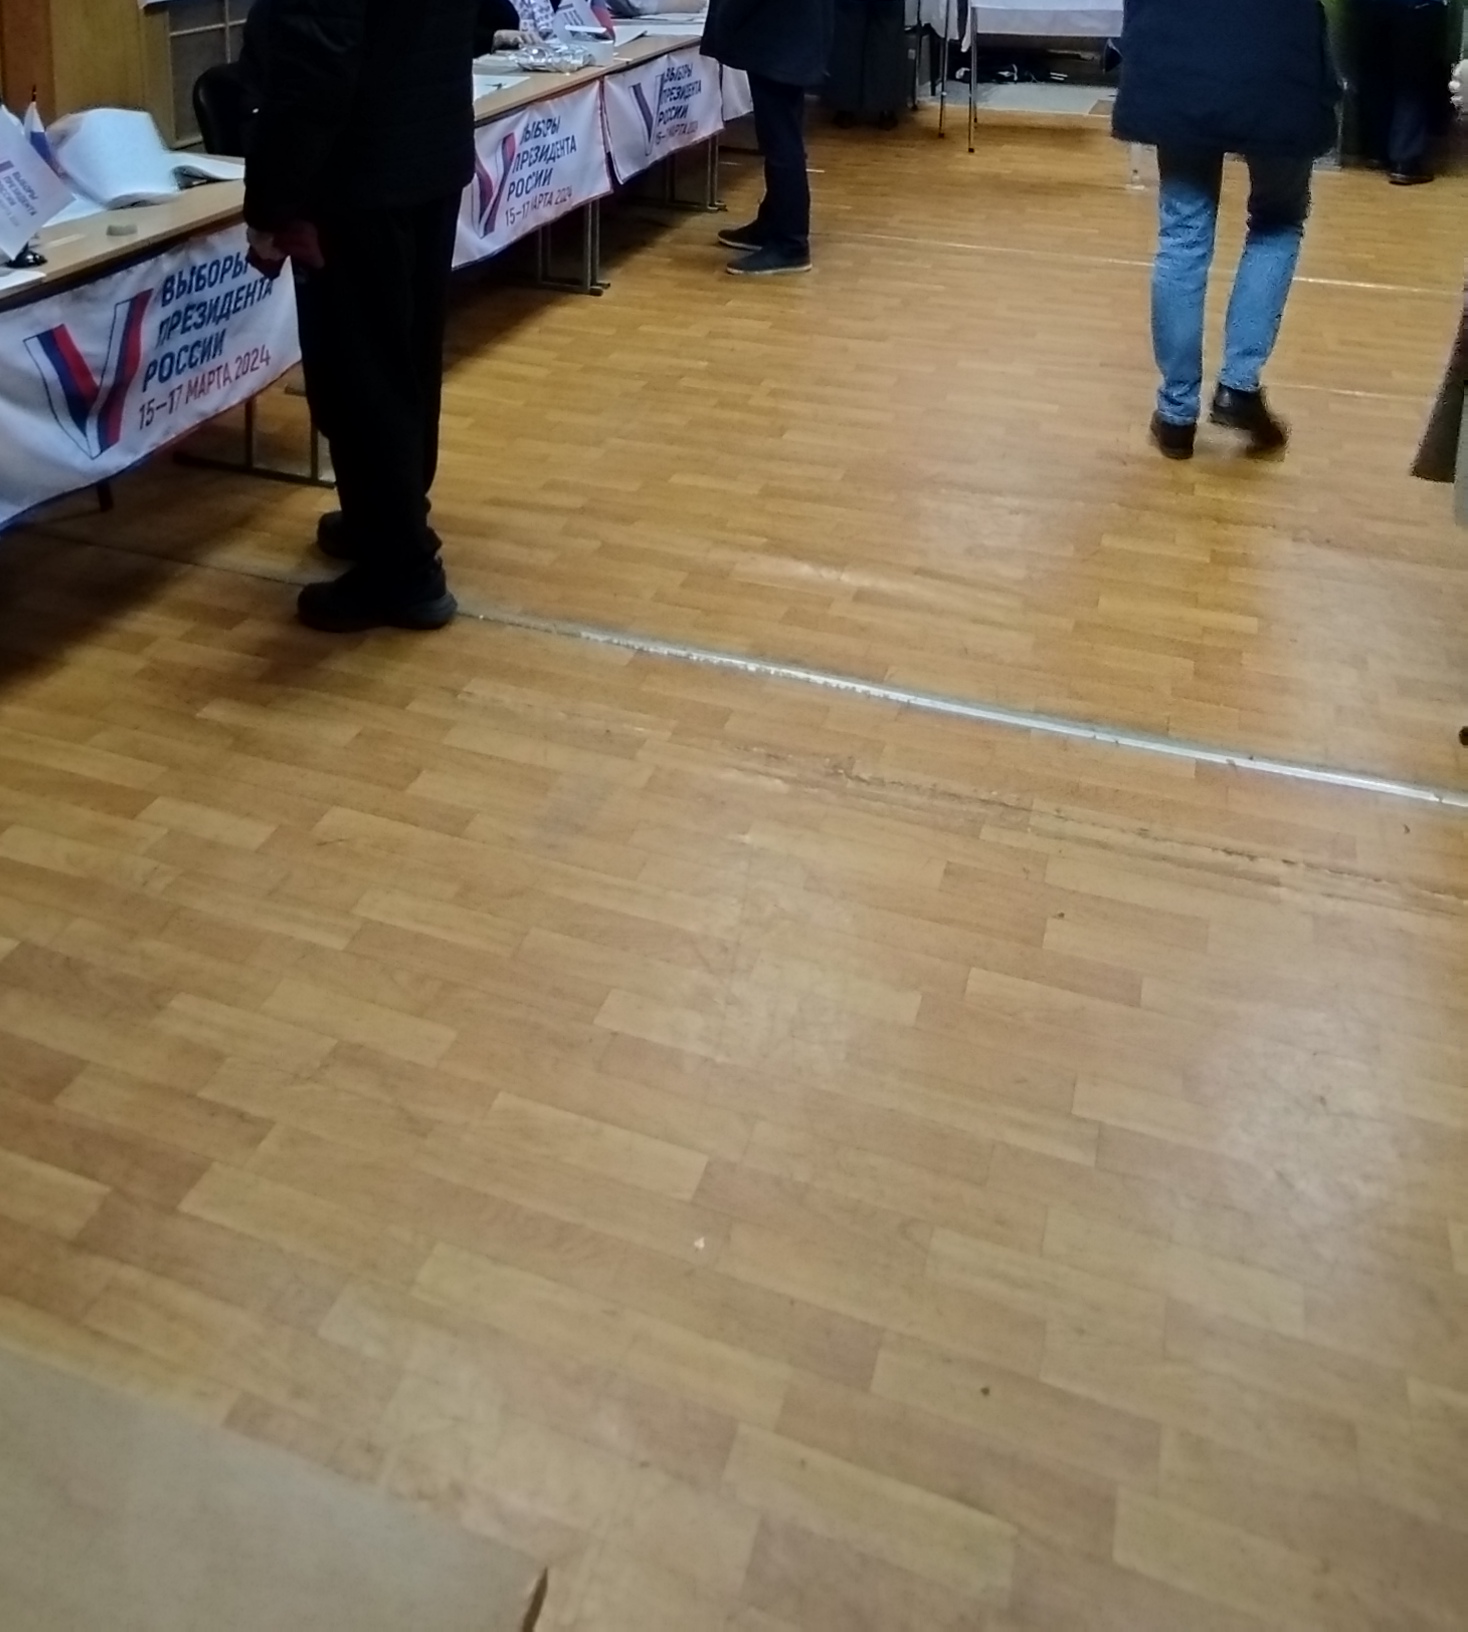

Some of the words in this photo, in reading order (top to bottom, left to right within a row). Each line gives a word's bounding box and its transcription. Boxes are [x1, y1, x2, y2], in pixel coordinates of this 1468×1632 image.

[512, 135, 577, 174] ПРЕЗИДЕНТА
[155, 278, 272, 350] ПРЕЗИДЕНТА
[142, 328, 227, 393] РОССИИ
[185, 363, 232, 404] МАРТА
[234, 344, 271, 380] 2024
